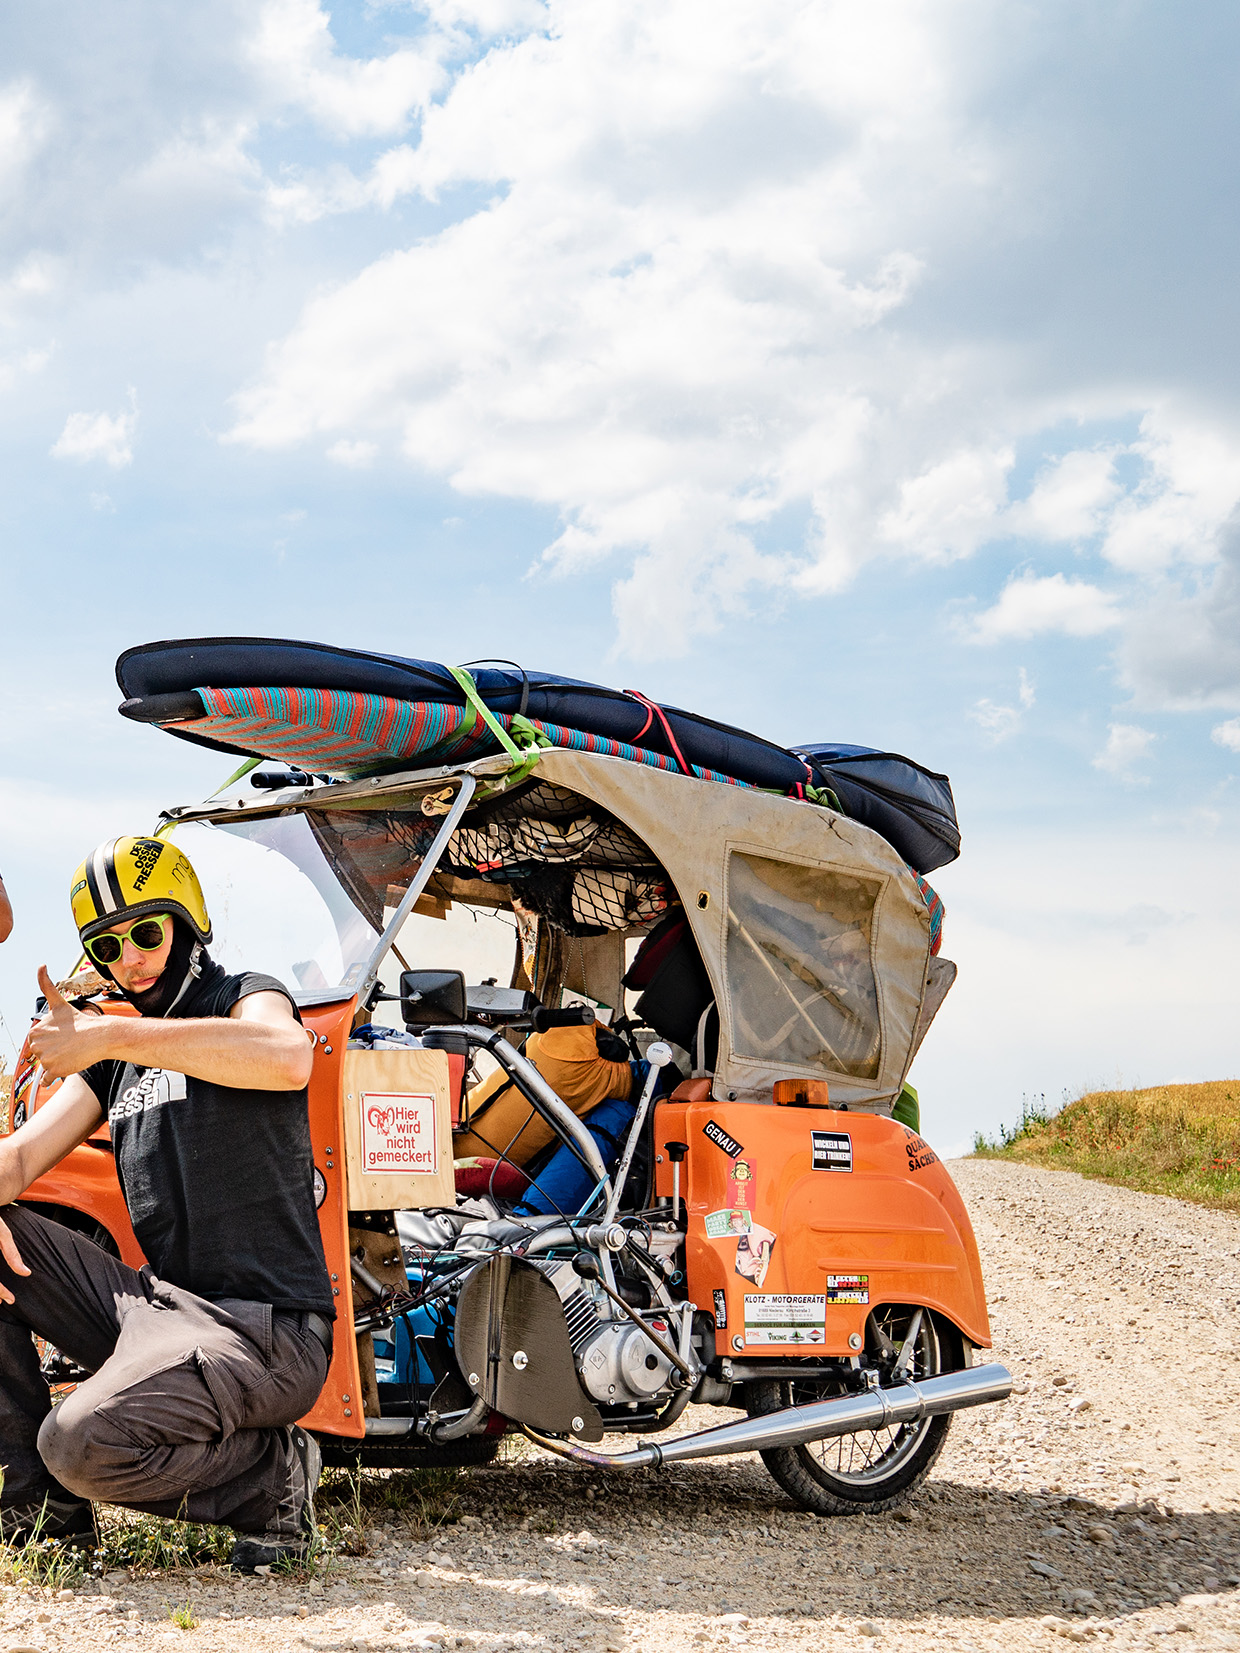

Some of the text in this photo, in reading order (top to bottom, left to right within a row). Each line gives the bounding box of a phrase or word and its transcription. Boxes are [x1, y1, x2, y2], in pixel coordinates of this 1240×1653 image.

[130, 844, 142, 856] DE
[395, 1107, 419, 1120] Hier
[396, 1121, 421, 1134] wird
[386, 1136, 415, 1149] nicht
[368, 1150, 432, 1165] gemeckert
